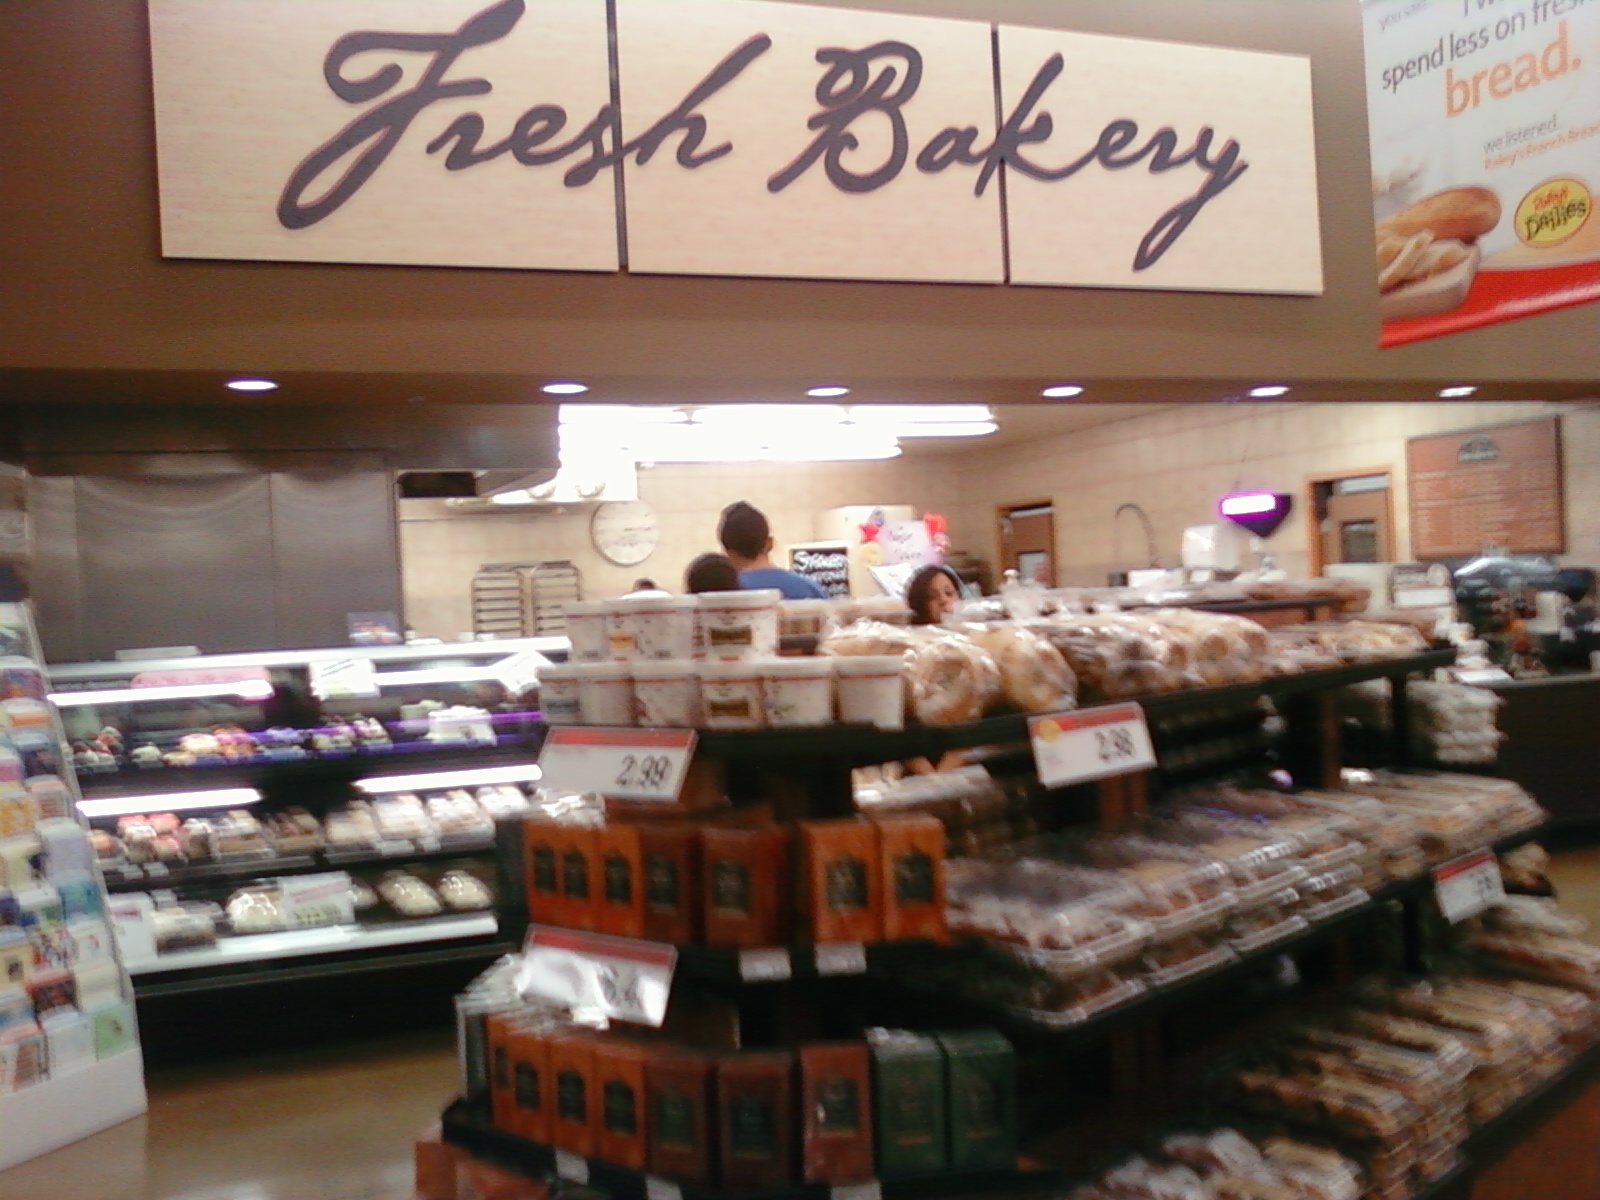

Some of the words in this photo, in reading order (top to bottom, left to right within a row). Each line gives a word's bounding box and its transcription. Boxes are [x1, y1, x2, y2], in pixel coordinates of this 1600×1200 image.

[1382, 37, 1445, 94] spend
[1449, 27, 1490, 62] less
[1495, 12, 1526, 41] on
[1531, 0, 1592, 26] fres
[1446, 18, 1582, 118] bread.
[277, 0, 772, 230] Fresh
[767, 40, 1249, 272] Bakery
